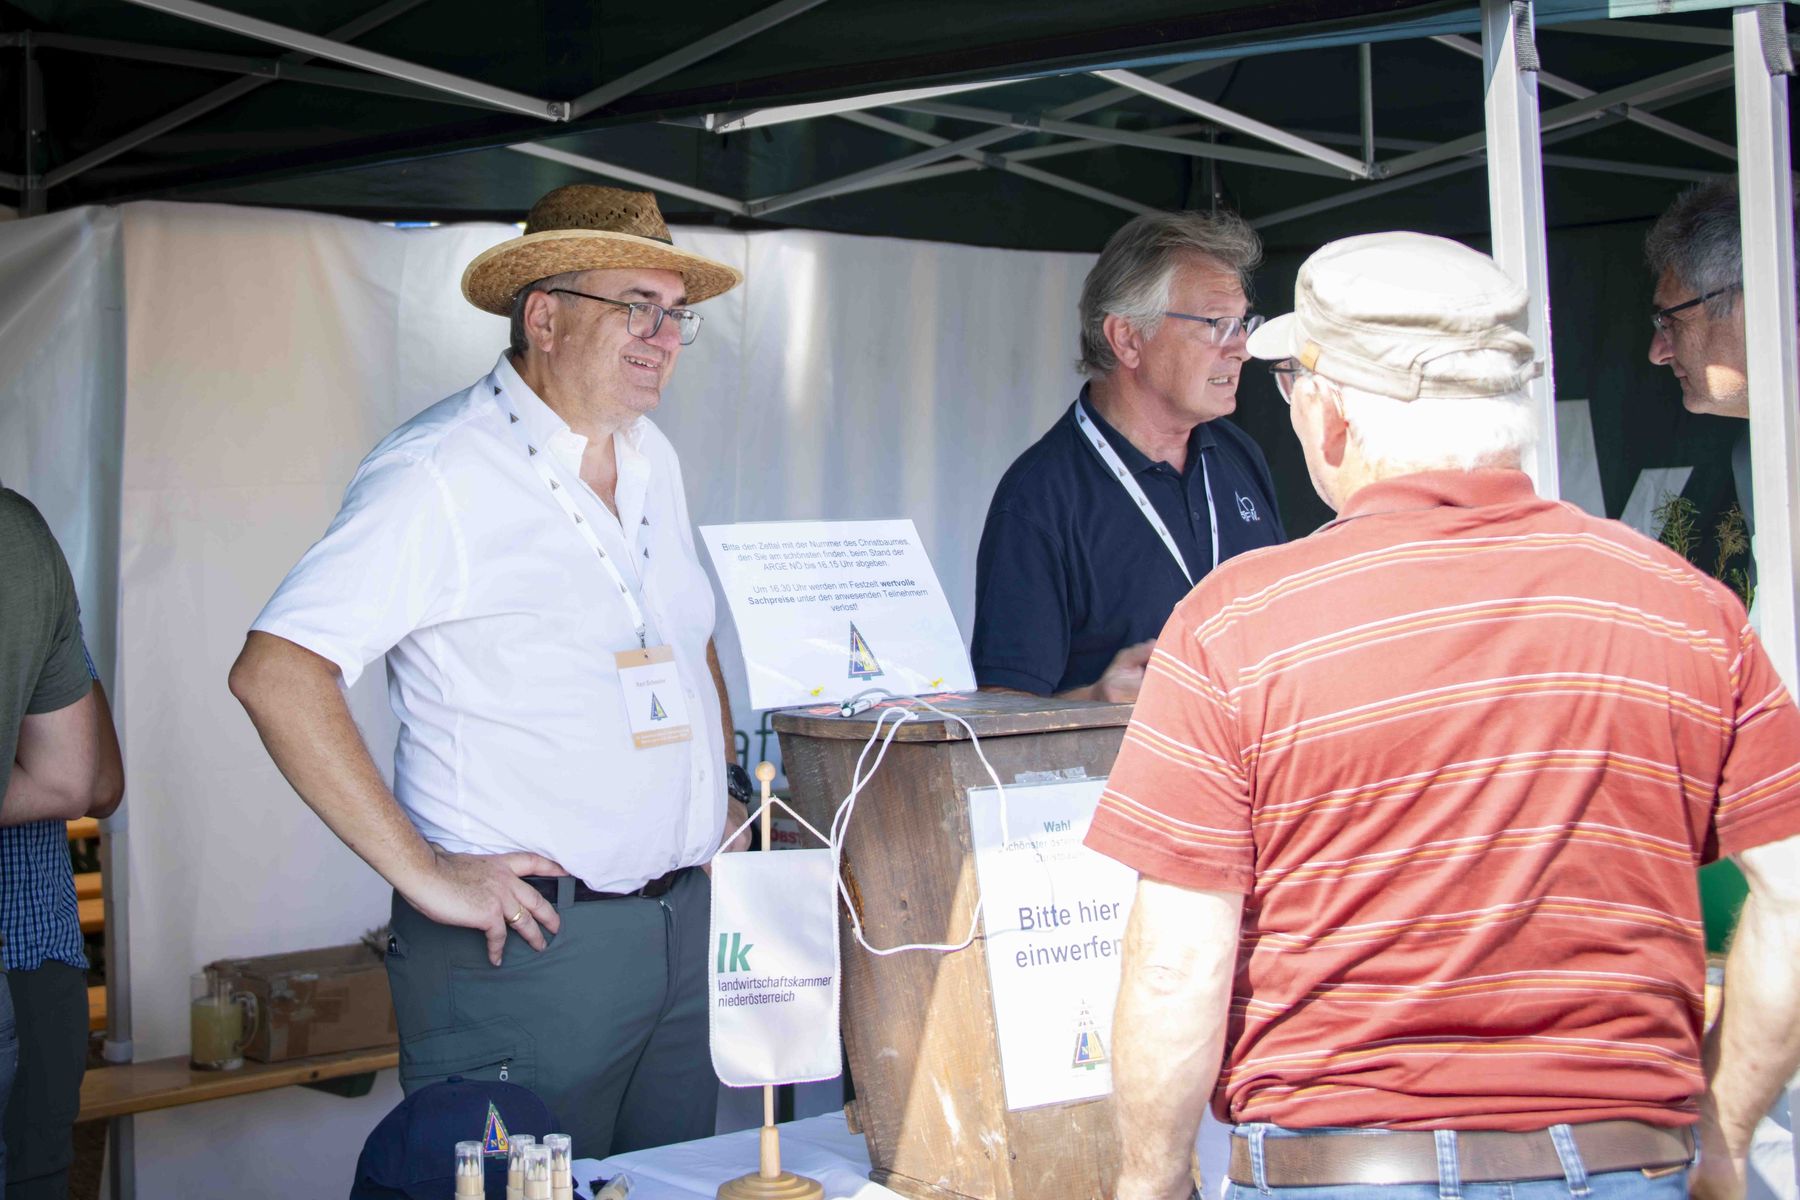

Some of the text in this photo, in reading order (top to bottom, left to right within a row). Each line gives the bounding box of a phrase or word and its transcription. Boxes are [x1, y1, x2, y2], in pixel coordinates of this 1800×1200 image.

[722, 542, 741, 551] Bitte
[742, 542, 758, 551] den
[758, 541, 781, 550] Zettel
[781, 541, 795, 549] mit
[796, 541, 808, 549] der
[809, 540, 842, 549] Nummer
[843, 539, 858, 547] des
[738, 554, 753, 562] den
[754, 552, 767, 561] Sie
[769, 553, 782, 561] am
[783, 551, 822, 560] schönsten
[849, 550, 868, 558] beim
[869, 548, 891, 557] Stand
[892, 548, 905, 556] der
[763, 562, 789, 571] ARGE
[804, 561, 817, 570] bis
[839, 560, 854, 568] Uhr
[752, 585, 768, 594] Um
[792, 583, 808, 592] Uhr
[808, 582, 838, 591] werden
[838, 581, 849, 590] im
[849, 580, 880, 589] Festzelt
[880, 578, 916, 588] wertvolle
[748, 589, 929, 606] Sachpreise unter den anwesenden Teilnehmern
[1043, 819, 1071, 833] Wahl
[1018, 899, 1120, 931] Bitte hier
[717, 932, 754, 974] lk
[718, 975, 833, 992] landwirtschaftskammer
[718, 990, 796, 1007] niederösterreich
